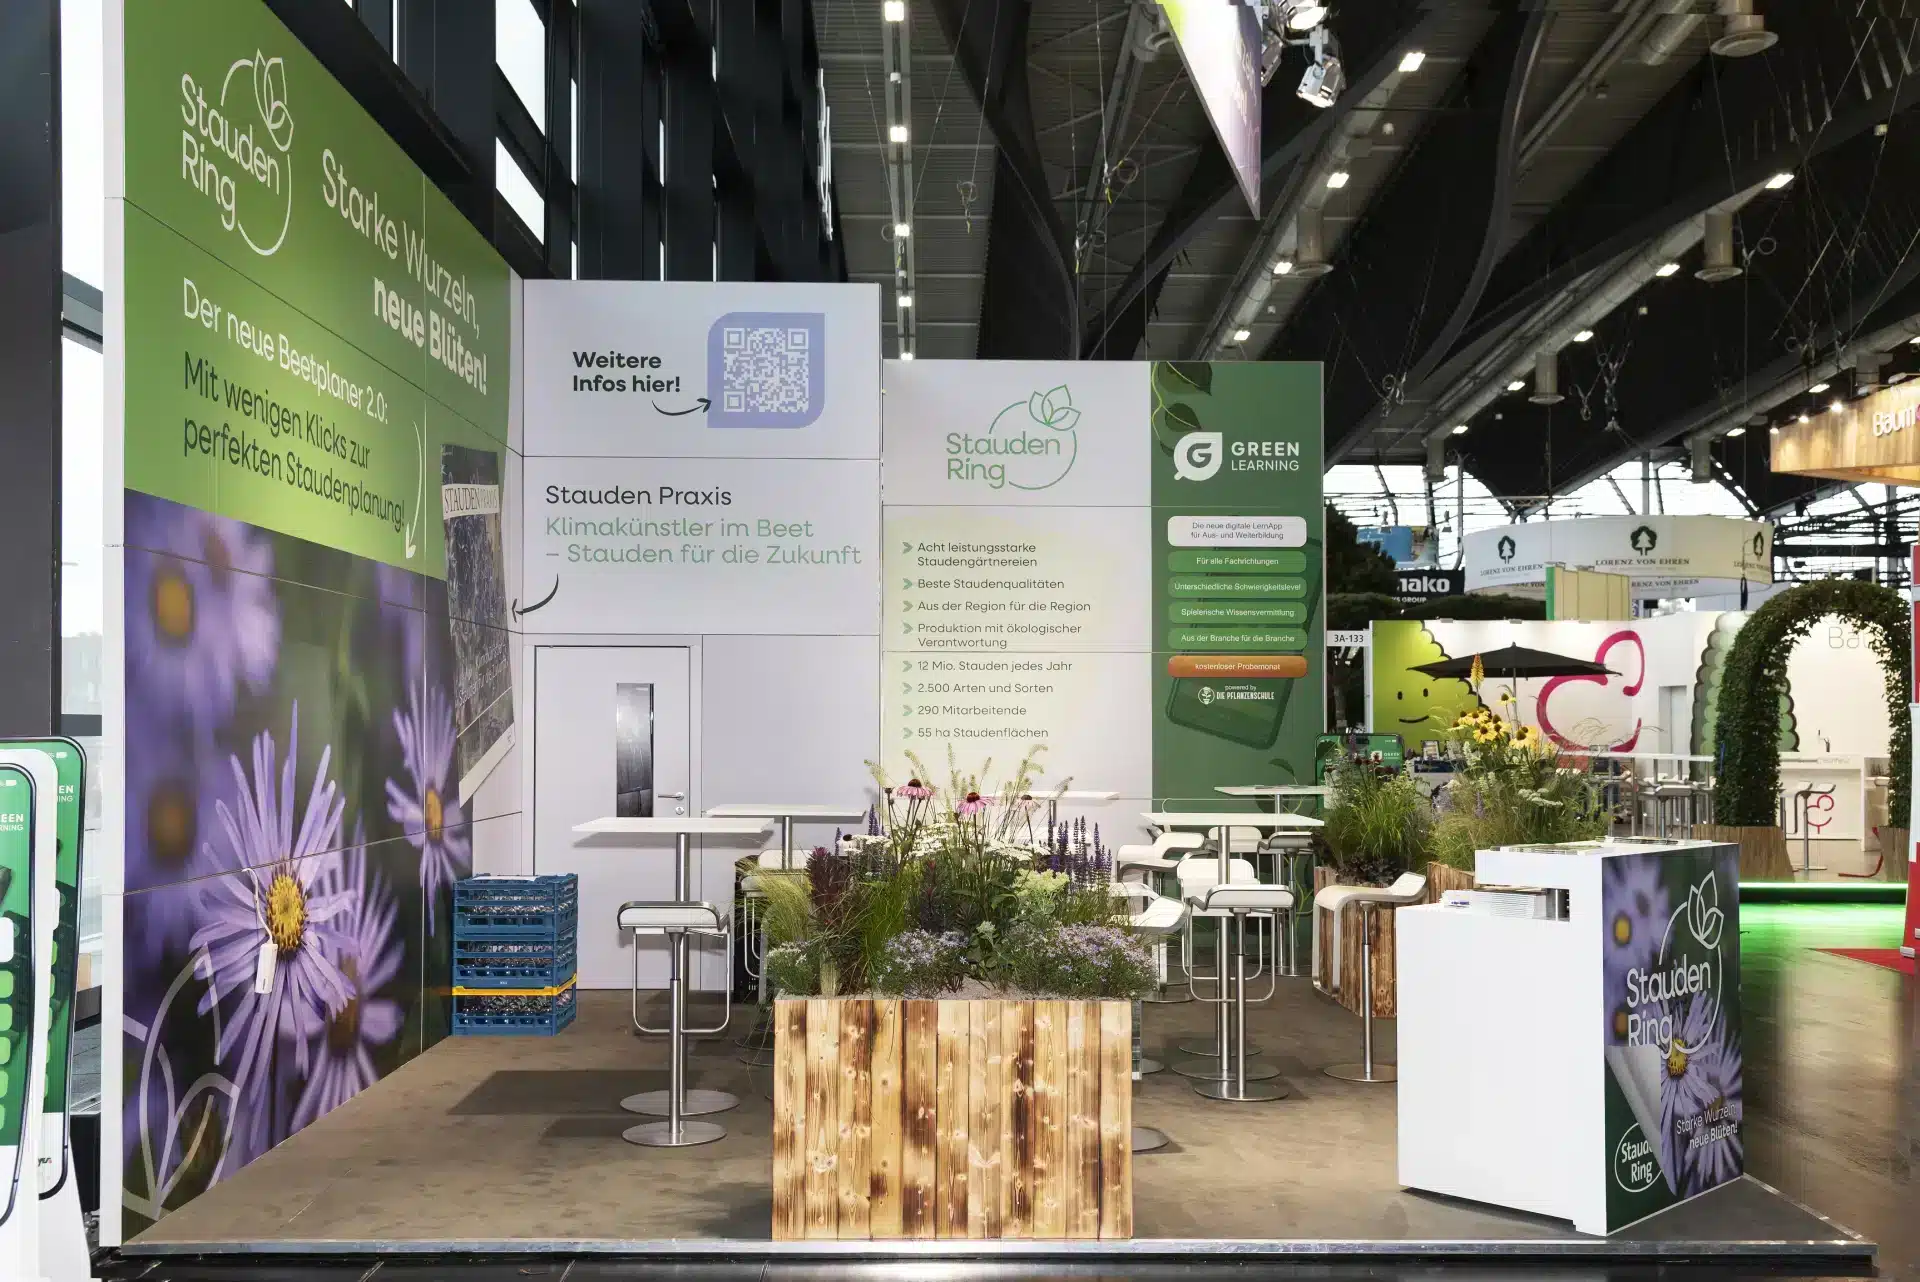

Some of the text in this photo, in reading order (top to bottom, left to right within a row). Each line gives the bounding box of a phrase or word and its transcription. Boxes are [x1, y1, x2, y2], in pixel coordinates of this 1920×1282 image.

[181, 73, 279, 195] Stauden
[182, 130, 236, 231] Ring
[322, 148, 481, 339] Starke Wurzeln,
[373, 276, 487, 396] neue Blüten!
[183, 277, 389, 424] Der neue Beetplaner 2.0:
[572, 351, 662, 369] Weitere
[572, 375, 680, 392] Infos hier!
[184, 351, 371, 470] Mit wenigen Klicks zur
[1872, 407, 1915, 436] Baum
[945, 431, 1061, 455] Stauden
[1231, 441, 1300, 456] GREEN
[1231, 460, 1300, 471] LEARNING
[184, 416, 405, 533] perfekten Staudenplanung!
[947, 457, 1005, 489] Ring
[545, 485, 732, 506] Stauden Praxis
[545, 517, 814, 538] Klimakünstler im Beet
[1192, 522, 1205, 530] Die
[1225, 522, 1251, 531] digitale
[1191, 531, 1201, 539] für
[1220, 531, 1234, 539] und
[1235, 531, 1284, 541] Weiterbildung
[567, 544, 674, 564] Stauden
[681, 545, 715, 564] für
[722, 545, 759, 564] die
[766, 546, 862, 565] Zukunft
[917, 542, 1037, 556] Acht leistungsstarke
[917, 556, 1038, 569] Staudengärtnereien
[1196, 557, 1209, 565] Für
[1224, 557, 1279, 567] Fachrichtungen
[1502, 565, 1516, 574] VON
[1517, 563, 1544, 573] EHREN
[1595, 558, 1633, 566] LORENZ
[917, 578, 1065, 591] Beste Staudenqualitäten
[1174, 582, 1301, 592] Unterschiedliche Schwierigkeitslevel
[917, 601, 1091, 614] Aus der Region für die Region
[1181, 608, 1295, 618] Spielerische Wissensvermittlung
[918, 623, 1082, 637] Produktion mit ökologischer
[918, 638, 1008, 650] Verantwortung
[1181, 635, 1295, 643] Aus der Branche für die Branche
[1333, 633, 1364, 644] 3A-133
[917, 661, 1073, 674] 12 Mio. Stauden jedes Jahr
[1195, 662, 1281, 671] kostenloser Probemonat
[917, 683, 1054, 694] 2.500 Arten und Sorten
[1224, 684, 1257, 692] powered by
[1216, 691, 1275, 701] DIE PFLANZENSCHULE
[917, 705, 1027, 716] 290 Mitarbeitende
[917, 728, 1049, 739] 55 ha Staudenflächen
[1626, 954, 1712, 1008] Stauden
[1628, 1011, 1673, 1060] Ring
[1676, 1113, 1703, 1135] Starke
[1689, 1120, 1738, 1150] neue Blüten!
[1631, 1160, 1653, 1184] Ring
